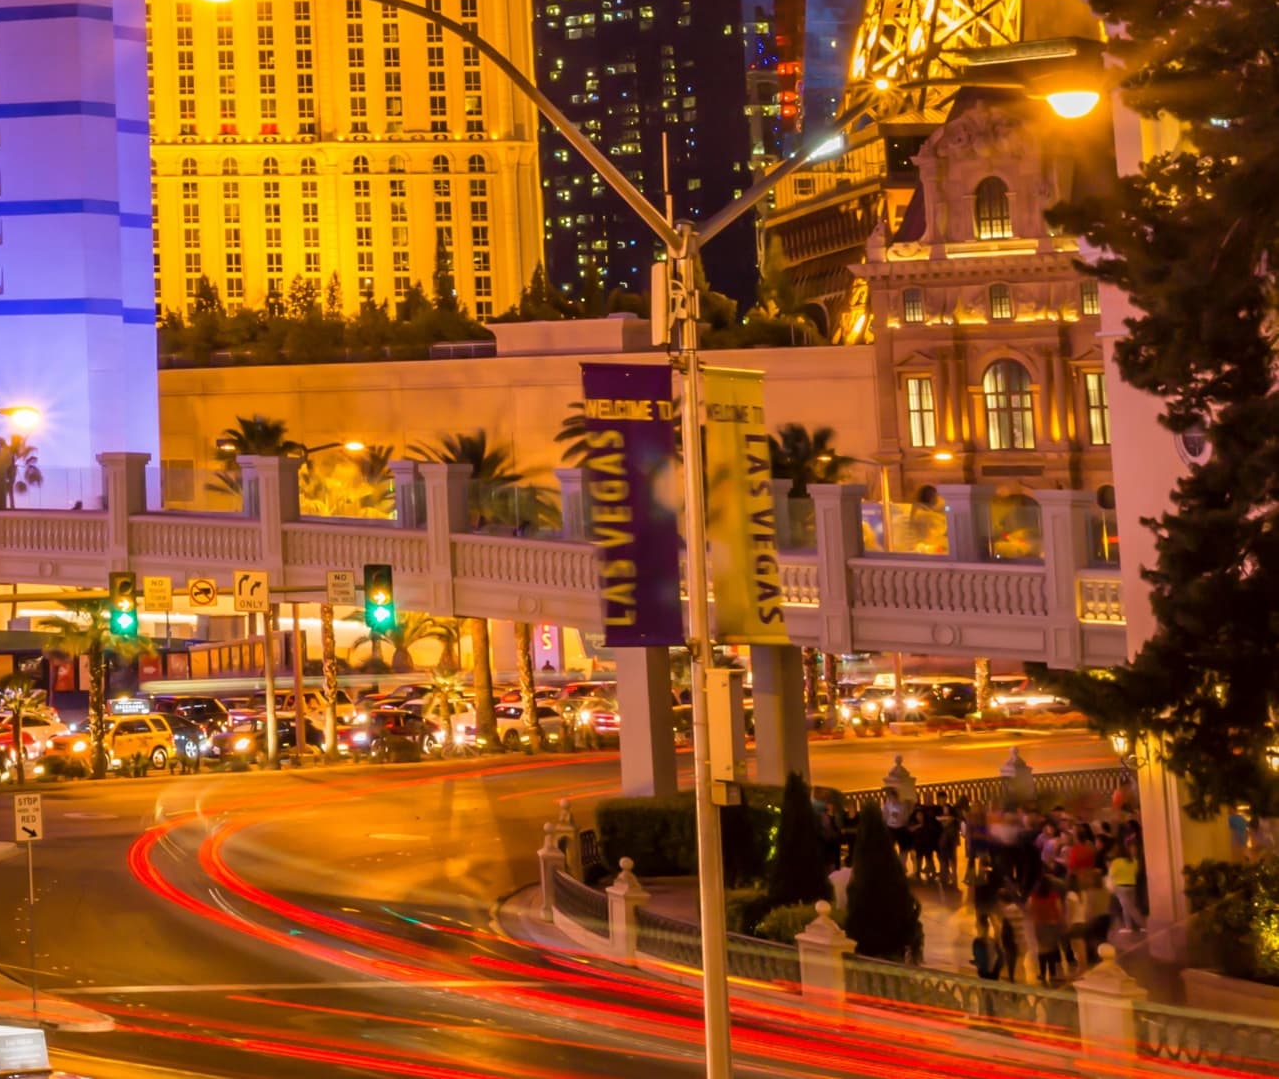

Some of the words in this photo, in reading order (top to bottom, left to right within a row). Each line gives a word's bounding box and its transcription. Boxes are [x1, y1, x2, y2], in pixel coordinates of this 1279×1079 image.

[586, 429, 635, 548] VEGAS
[744, 434, 770, 498] LAS
[602, 558, 637, 626] LAS
[749, 509, 785, 625] VEGAS
[240, 600, 263, 609] ONLY
[17, 797, 38, 806] STOP
